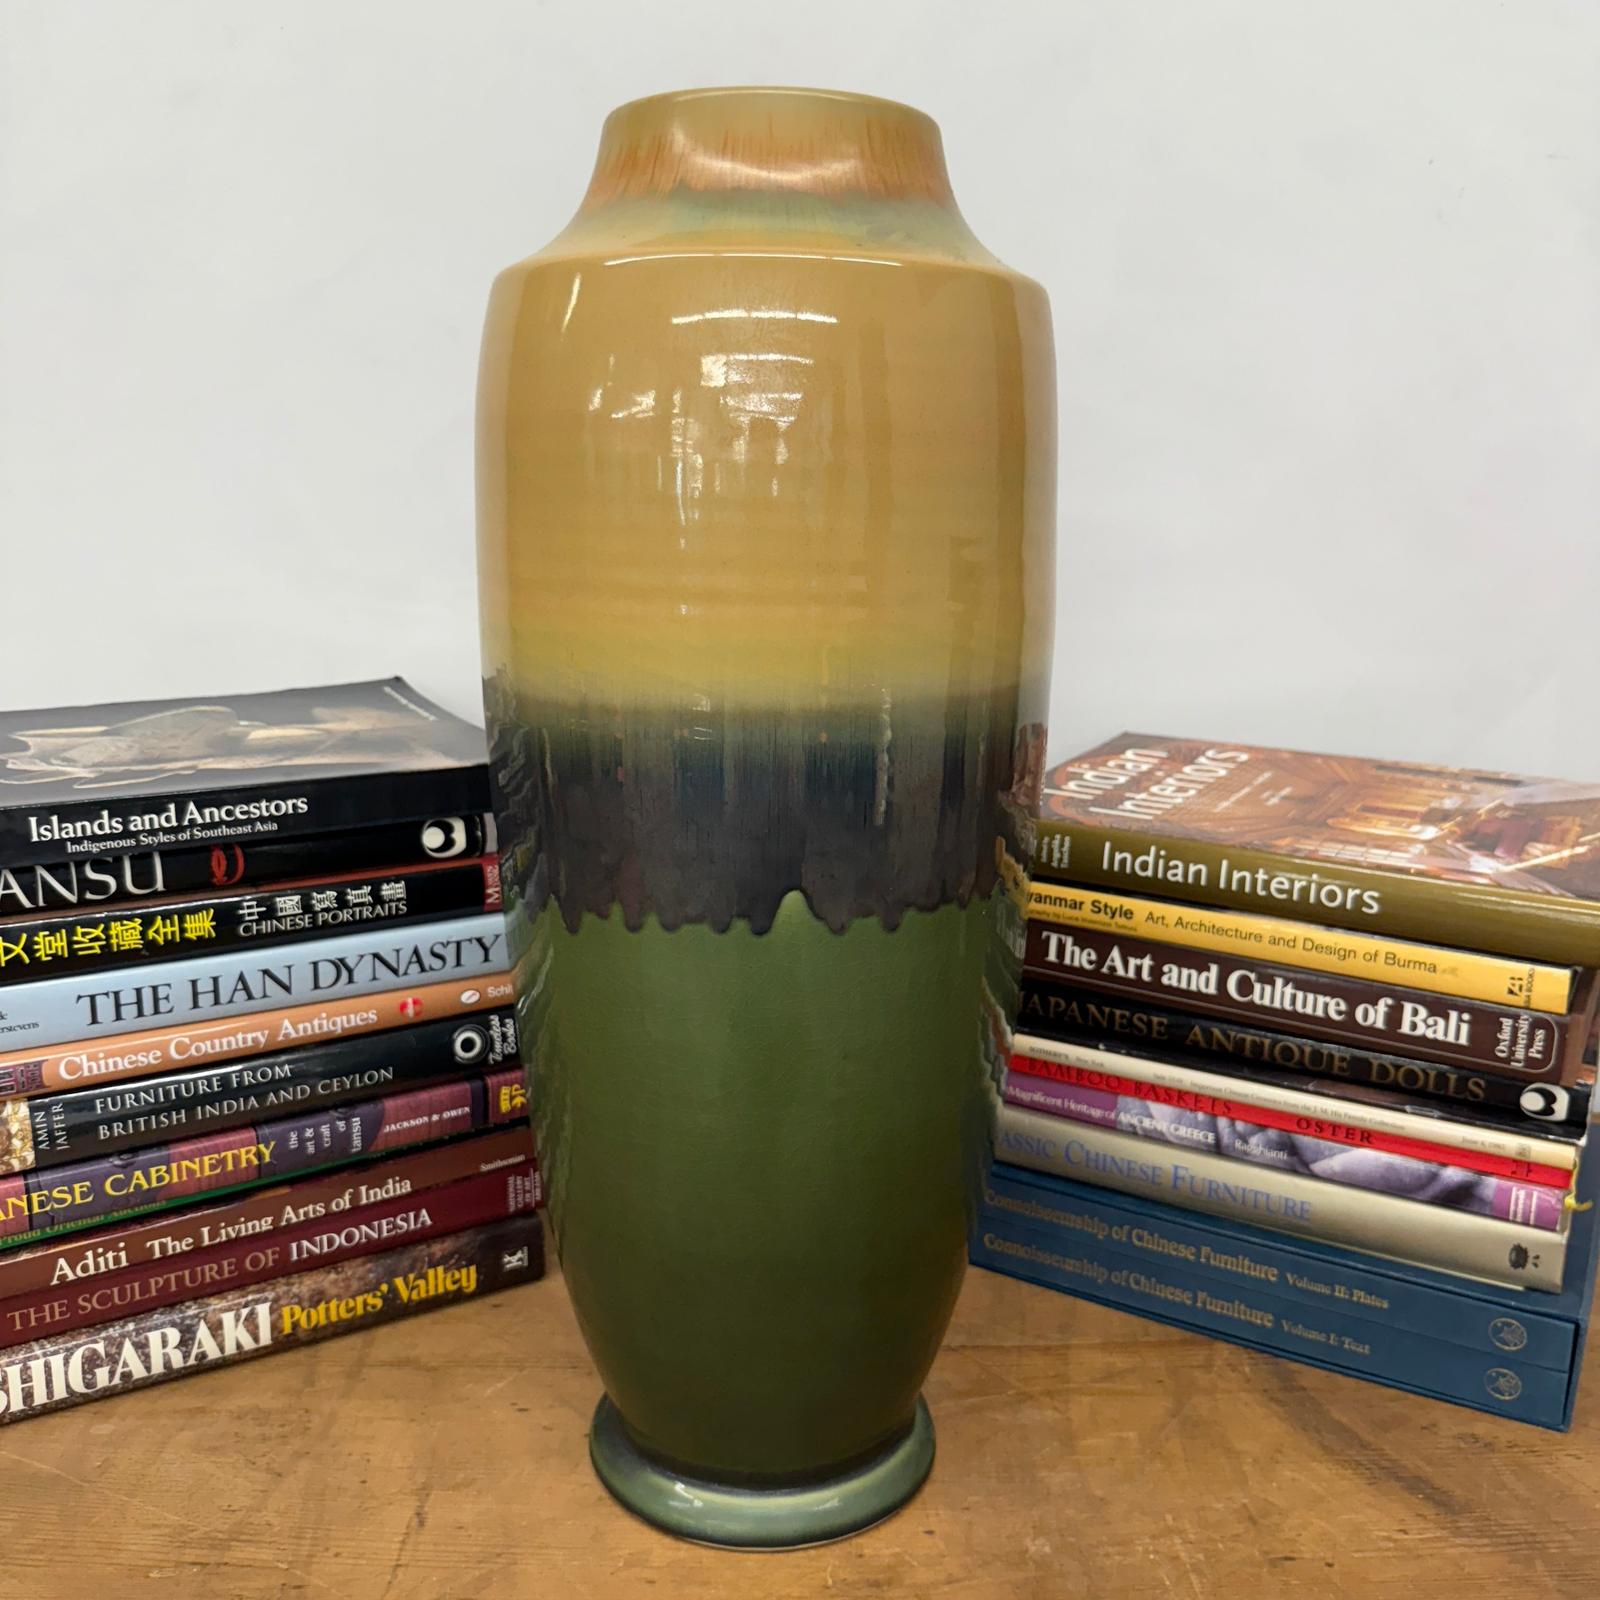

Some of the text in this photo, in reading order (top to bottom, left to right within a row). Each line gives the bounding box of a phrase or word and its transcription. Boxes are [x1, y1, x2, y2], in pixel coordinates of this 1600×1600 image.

[1044, 748, 1168, 800] Indian
[1089, 749, 1249, 819] Interiors
[29, 797, 308, 842] Islands and Ancestors
[67, 821, 278, 853] Indigenous Styles of Southeast Asia
[1102, 841, 1208, 886] Indian
[1219, 858, 1381, 914] Interiors
[239, 901, 407, 937] CHINESE PORTRAITS
[1090, 900, 1134, 920] Style
[1145, 911, 1169, 929] Art,
[1174, 916, 1263, 943] Architecture
[1267, 933, 1296, 949] and
[1302, 937, 1357, 961] Design
[1363, 947, 1379, 962] of
[1384, 952, 1437, 974] Burma
[75, 934, 502, 1025] THE HAN DYNASTY
[1041, 930, 1471, 1046] The Art and Culture of Bali
[58, 1009, 378, 1080] Chinese Country Antiques
[501, 1018, 517, 1055] Books
[1495, 1018, 1513, 1057] Oxford
[1511, 1015, 1532, 1067] University
[1528, 1029, 1545, 1059] Press
[95, 1063, 291, 1114] FURNITURE FROM
[1185, 1025, 1350, 1076] ANTIQUE
[1368, 1057, 1486, 1101] DOLLS
[99, 1067, 394, 1141] BRITISH INDIA AND CEYLON
[337, 1119, 347, 1131] of
[383, 1106, 470, 1134] JACKSON & OWEN
[1028, 1057, 1373, 1144] BAMBOO BASKETS OSTER
[35, 1111, 50, 1150] AMIN
[288, 1131, 298, 1149] the
[322, 1123, 331, 1147] craft
[350, 1117, 362, 1152] tansu
[1118, 1111, 1168, 1134] ANCIENT
[1169, 1122, 1216, 1145] GREECE
[104, 1141, 276, 1197] CABINETRY
[1064, 1139, 1163, 1185] CHINESE
[1171, 1164, 1311, 1222] FURNITURE
[50, 1242, 130, 1286] Aditi
[146, 1236, 194, 1260] The
[201, 1214, 274, 1247] Living
[280, 1201, 326, 1226] Arts
[331, 1188, 353, 1213] of
[359, 1176, 412, 1206] India
[6, 1208, 432, 1332] THE SCULPTURE OF INDONESIA
[393, 1264, 477, 1304] Valley
[1112, 1225, 1129, 1241] of
[1132, 1227, 1196, 1260] Chinese
[1200, 1245, 1278, 1282] Furniture
[1286, 1273, 1331, 1296] Volume
[1351, 1288, 1390, 1310] Plates
[1111, 1269, 1129, 1286] of
[1129, 1271, 1194, 1305] Chinese
[1196, 1291, 1274, 1328] Furniture
[1281, 1317, 1327, 1343] Volume
[1341, 1335, 1371, 1355] Text
